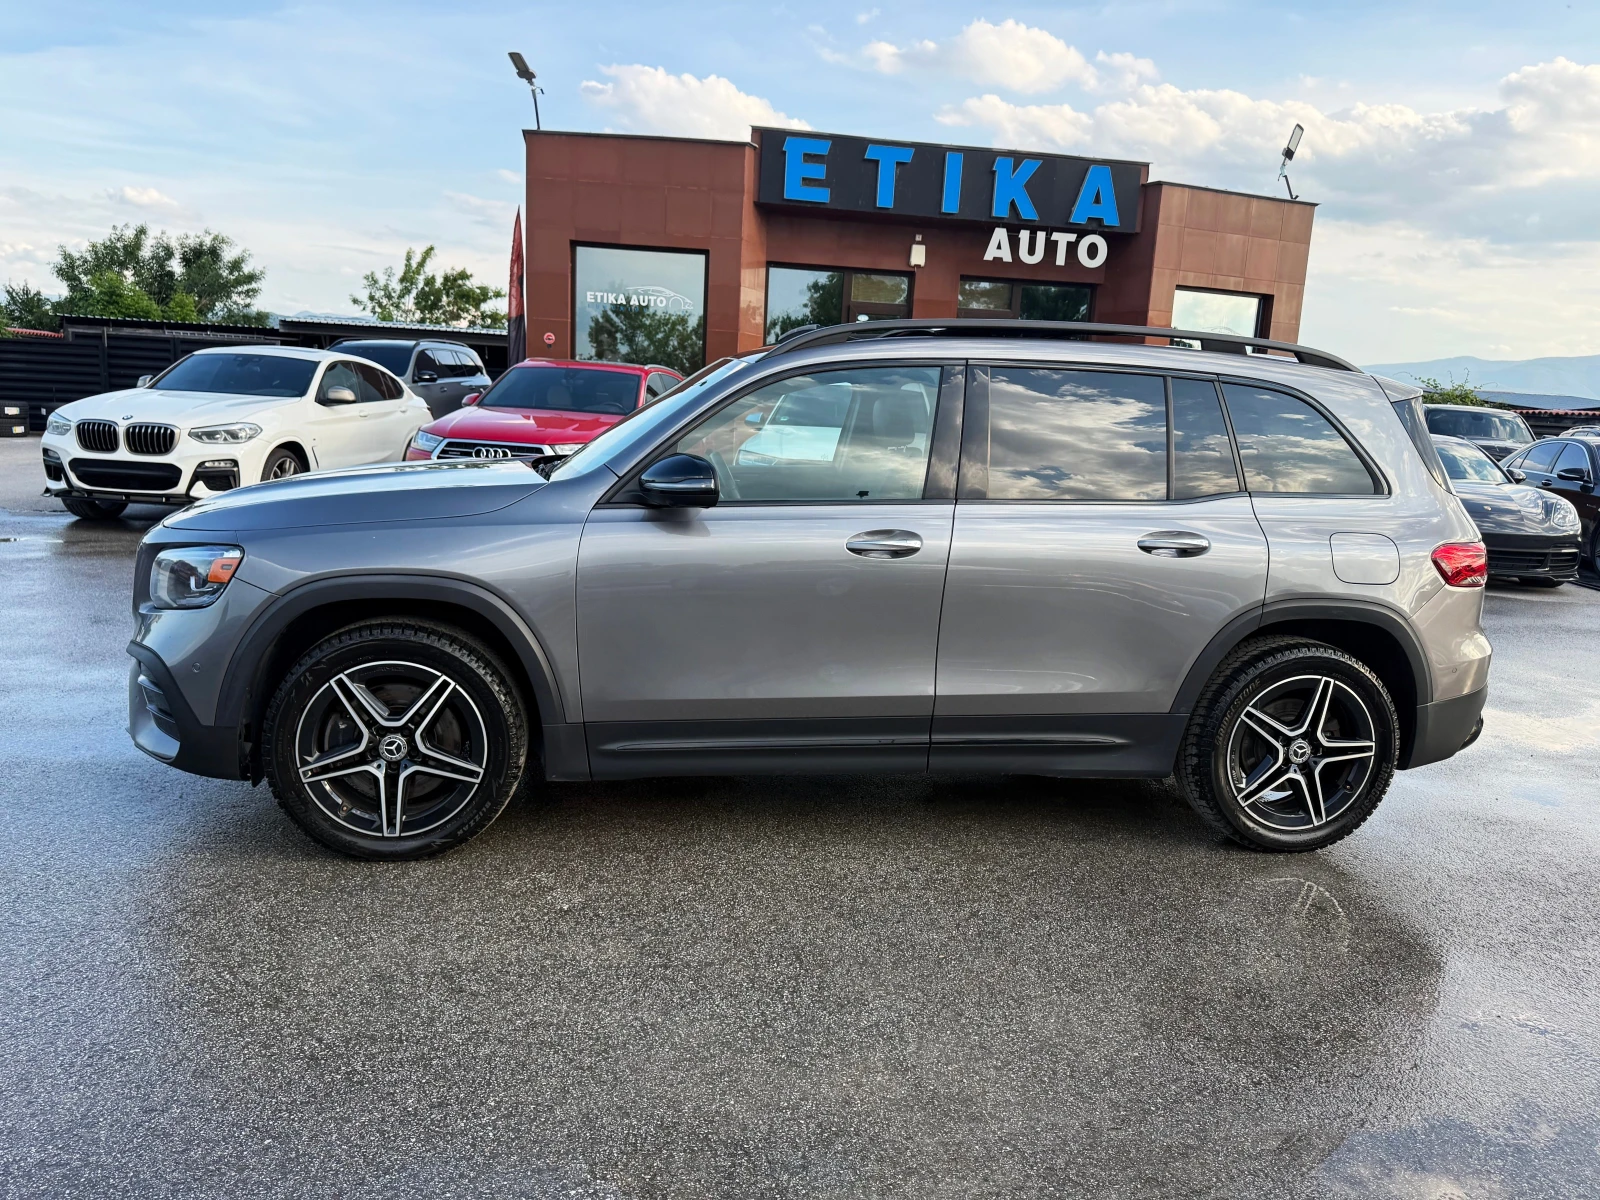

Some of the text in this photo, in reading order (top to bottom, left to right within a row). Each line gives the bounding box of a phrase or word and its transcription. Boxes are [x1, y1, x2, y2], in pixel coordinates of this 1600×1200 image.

[783, 136, 1121, 227] ETIKA
[983, 227, 1108, 269] AUTO
[586, 291, 667, 307] ETIKA AUTO
[457, 801, 491, 836] BLIZZAK
